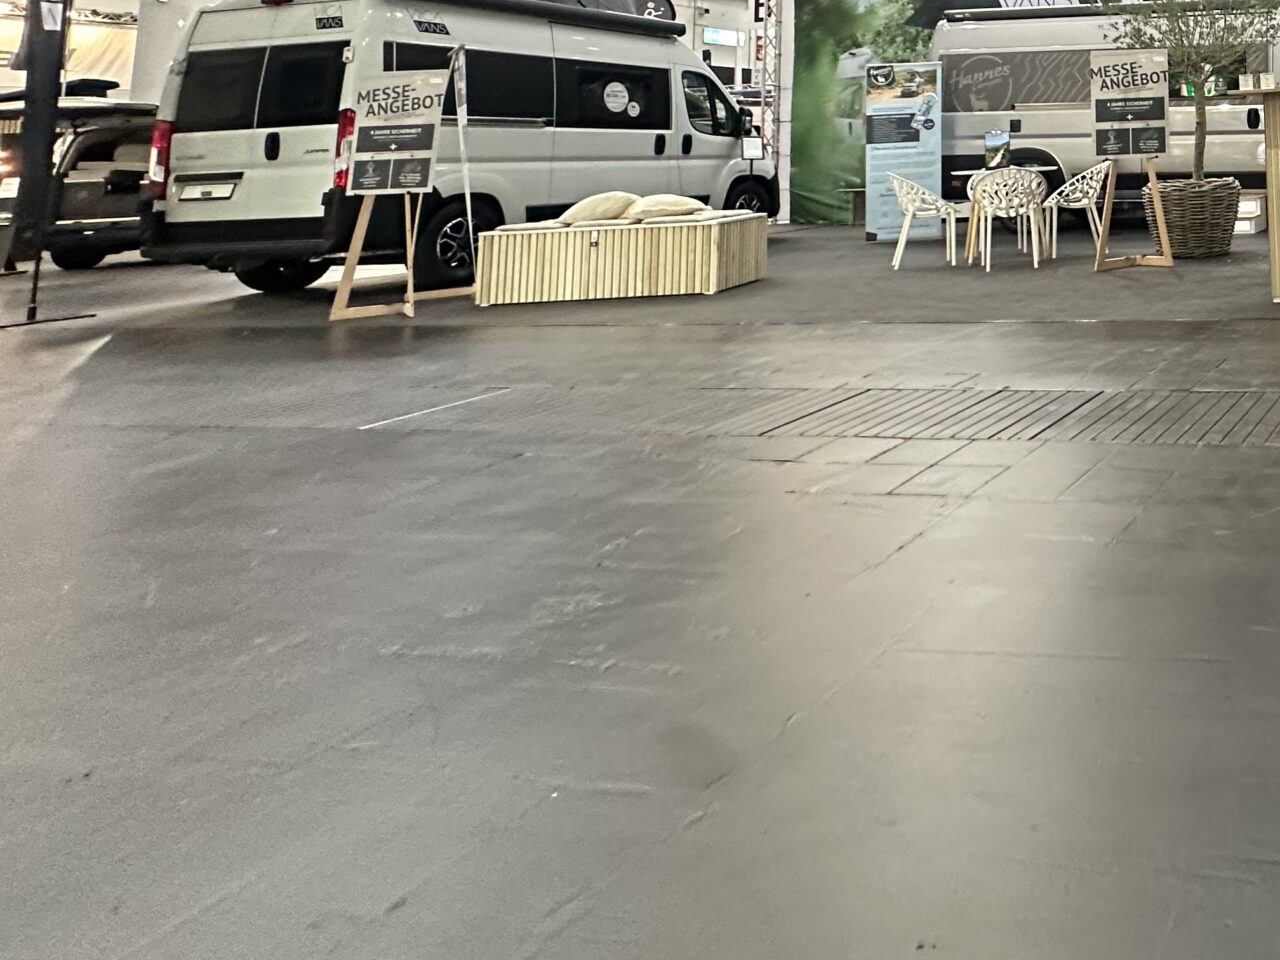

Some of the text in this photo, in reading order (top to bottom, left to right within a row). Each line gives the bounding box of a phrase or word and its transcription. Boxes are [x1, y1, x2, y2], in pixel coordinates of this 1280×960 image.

[316, 18, 342, 28] VANS
[416, 22, 447, 34] VANS
[949, 64, 1011, 91] Hannes
[1090, 62, 1143, 80] MESSE-
[1100, 70, 1168, 91] ANGEBOT
[357, 84, 417, 105] MESSE-
[365, 93, 444, 118] ANGEBOT
